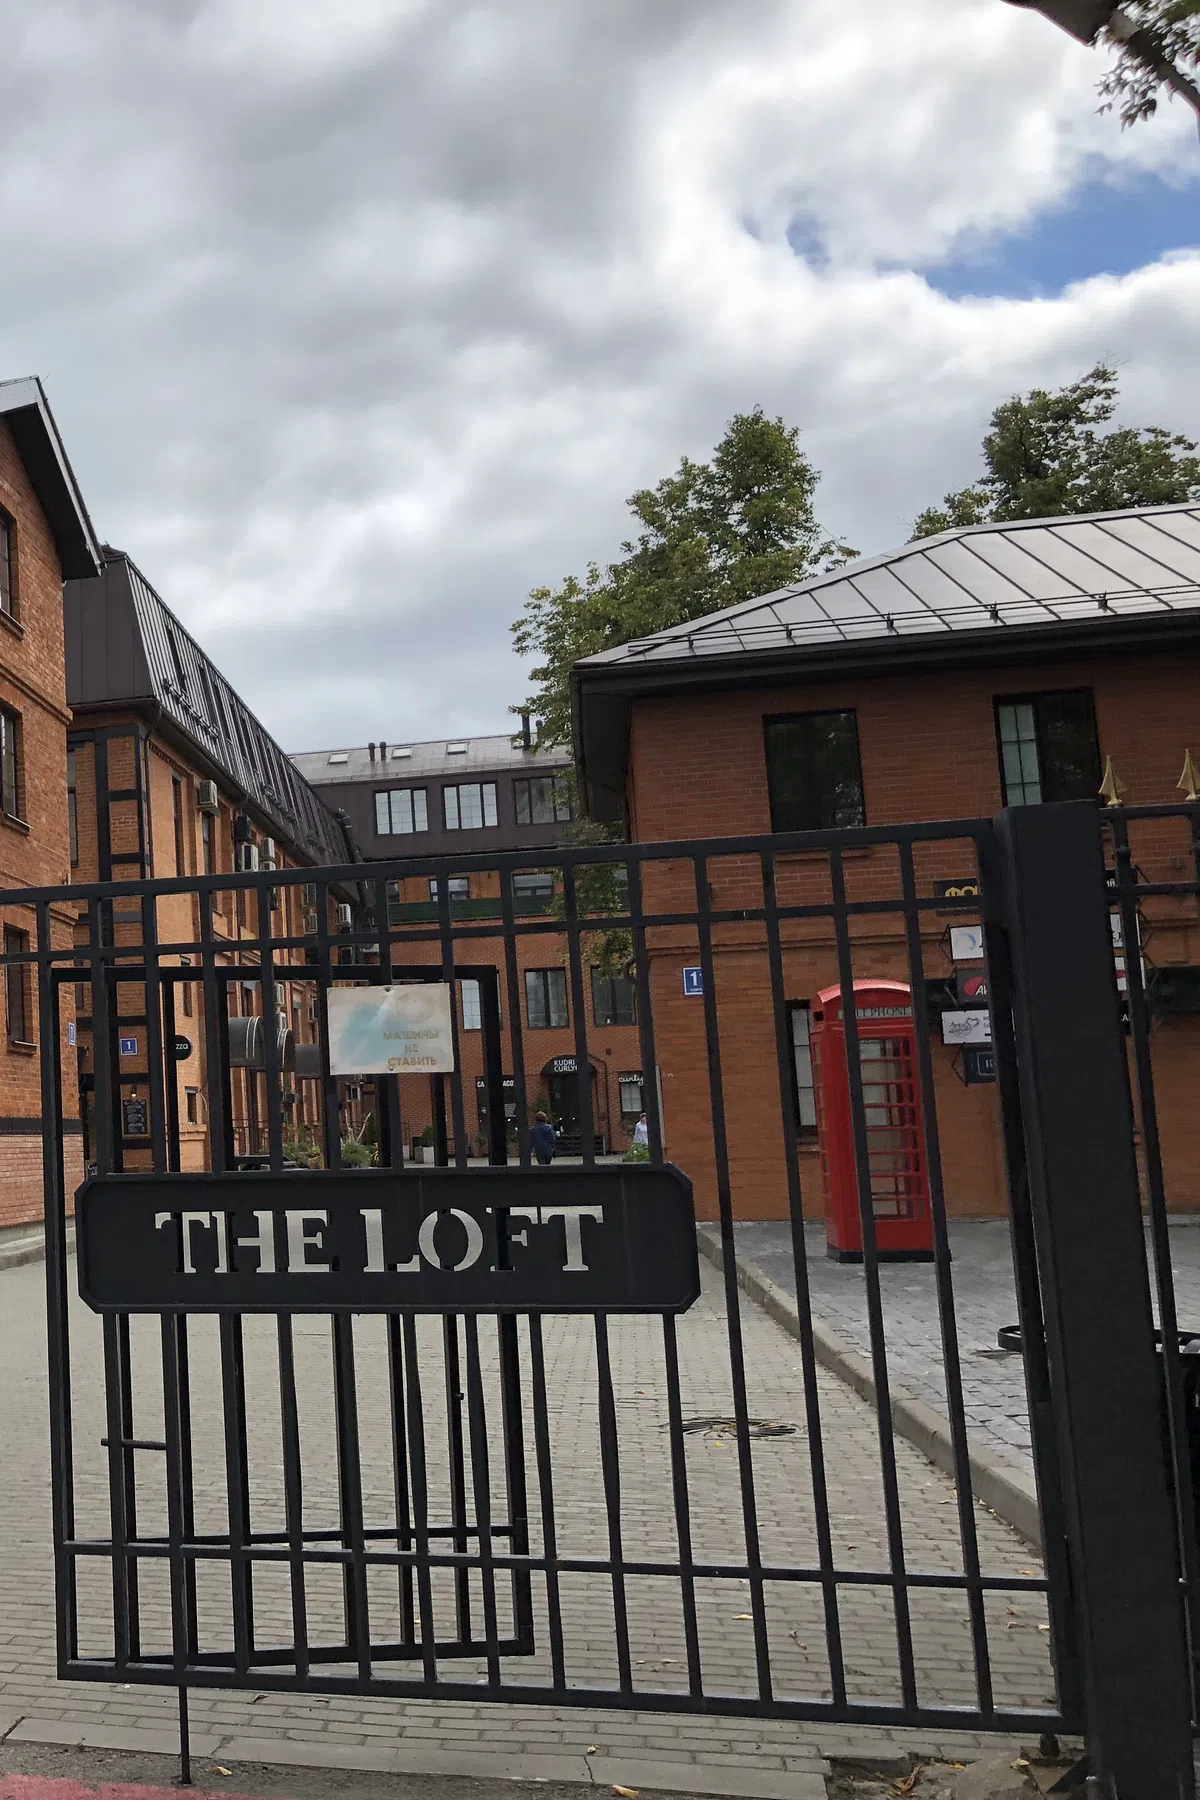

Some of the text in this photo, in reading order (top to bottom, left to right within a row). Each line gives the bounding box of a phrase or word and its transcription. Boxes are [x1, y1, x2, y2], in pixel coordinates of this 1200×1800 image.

[383, 1030, 439, 1040] МАШИНЫ
[405, 1044, 419, 1053] НЕ
[388, 1056, 437, 1067] СТАВИТЬ
[154, 1204, 604, 1274] THE LOFT
